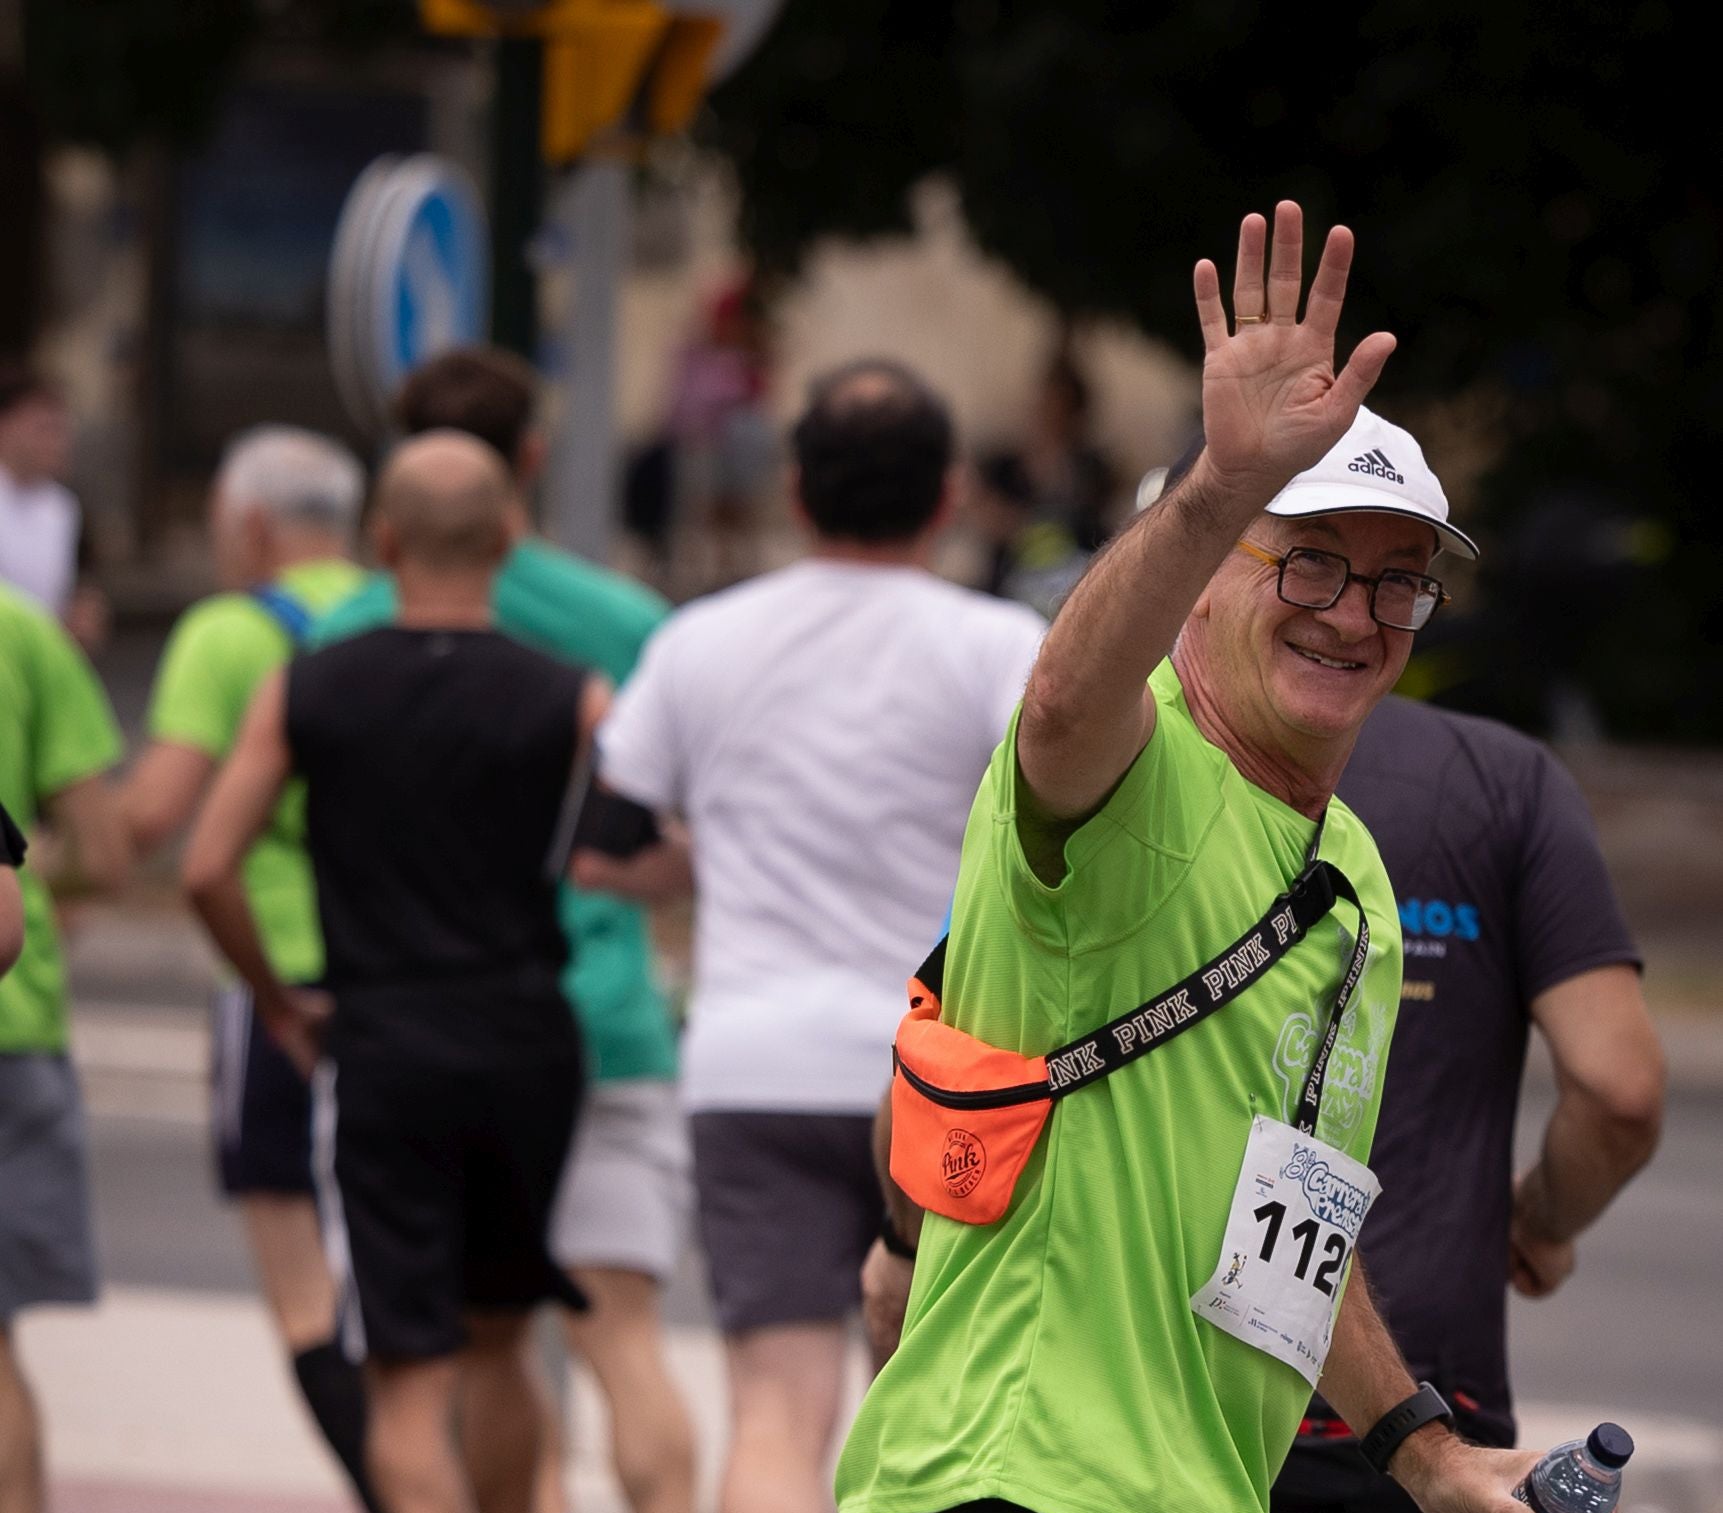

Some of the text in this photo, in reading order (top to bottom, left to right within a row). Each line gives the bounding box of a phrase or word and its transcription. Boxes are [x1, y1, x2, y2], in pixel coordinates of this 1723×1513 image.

[1348, 463, 1404, 485] adidas
[1047, 905, 1297, 1091] INK PINK PINK PI
[1305, 923, 1370, 1106] PINK PINK
[1253, 1200, 1352, 1302] 112
